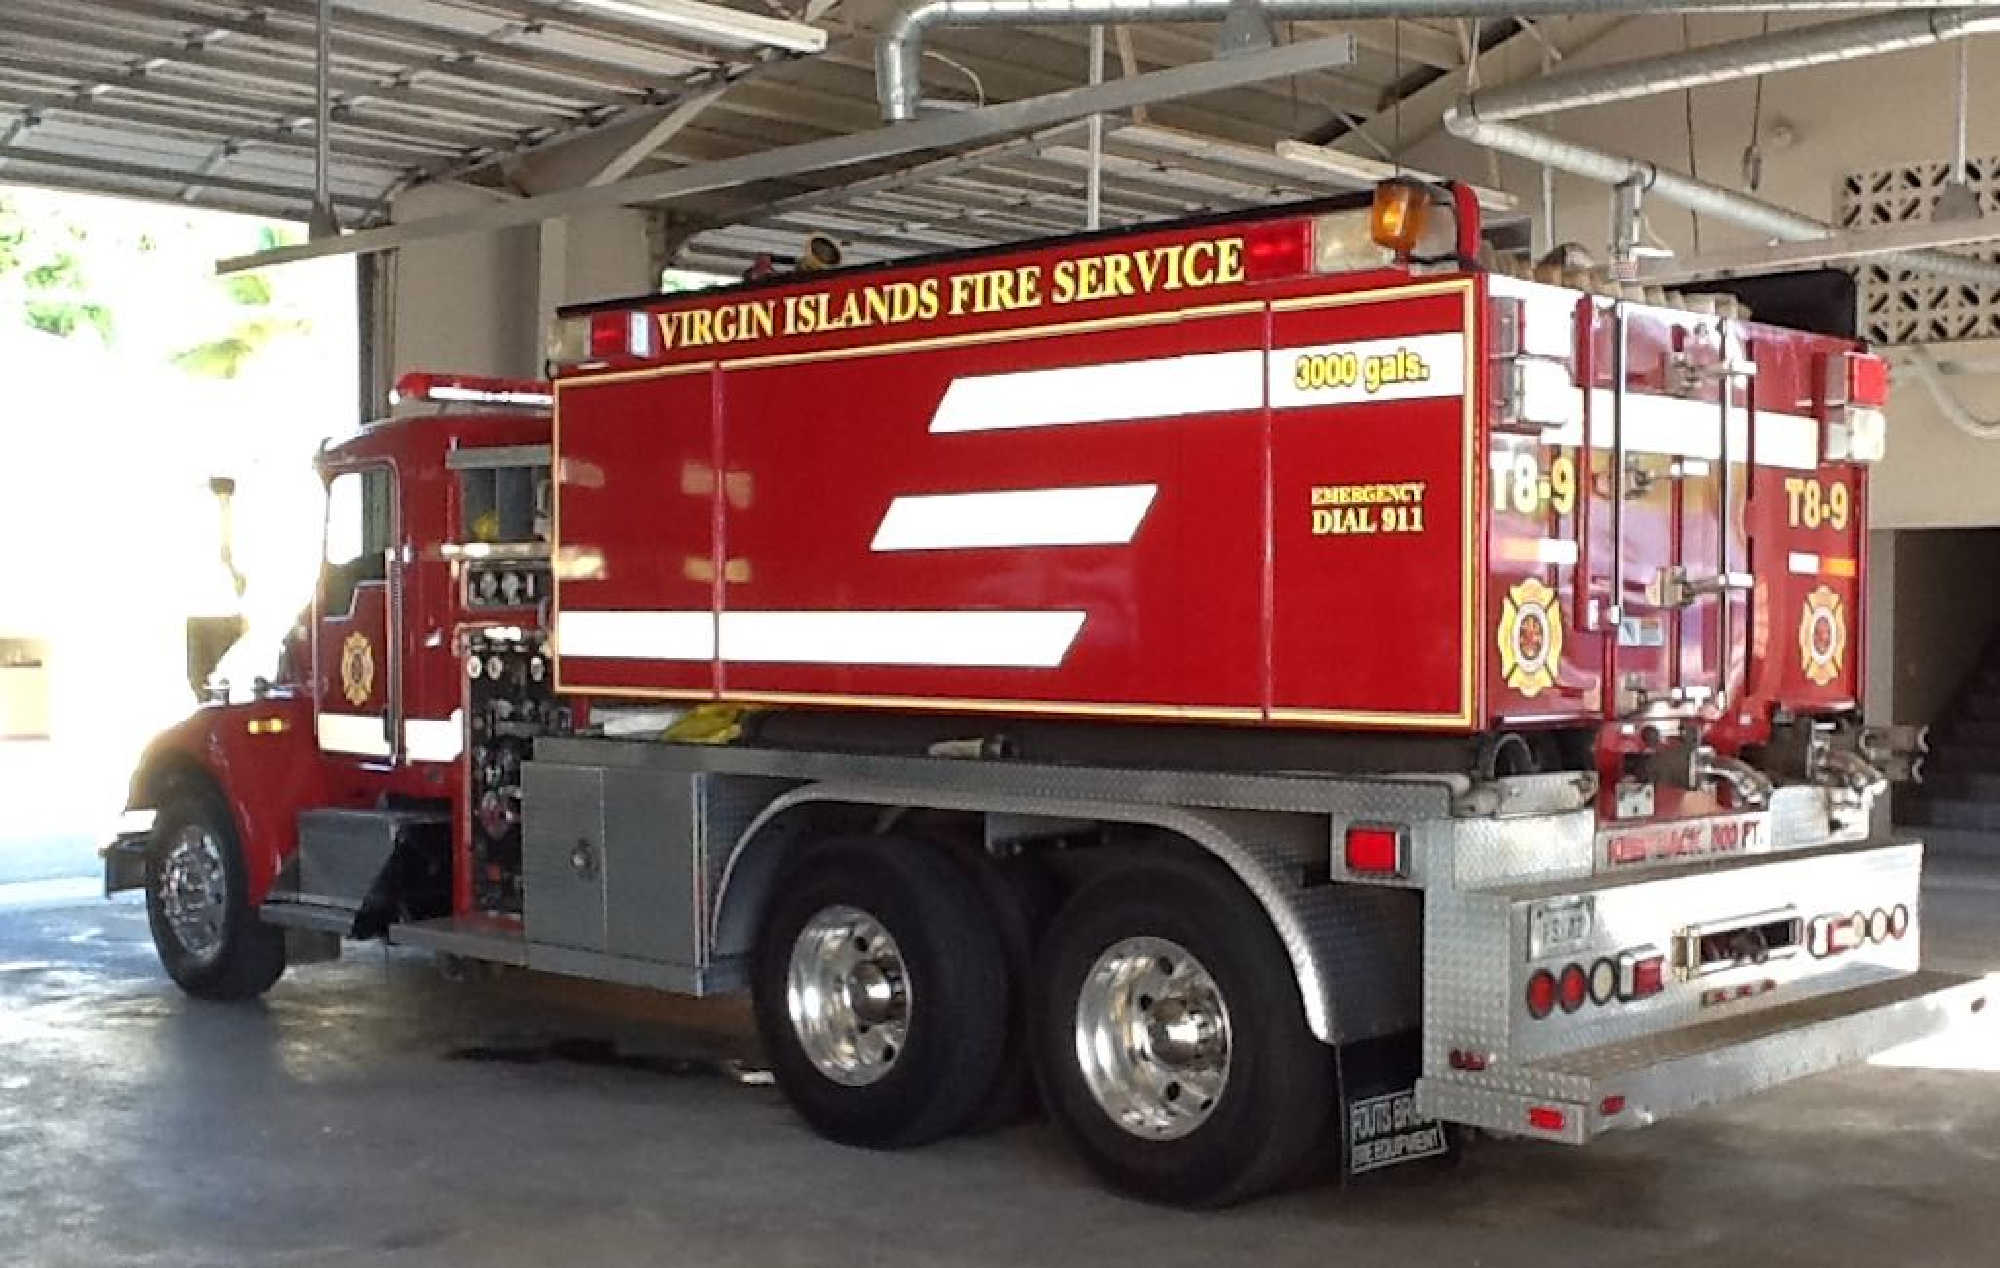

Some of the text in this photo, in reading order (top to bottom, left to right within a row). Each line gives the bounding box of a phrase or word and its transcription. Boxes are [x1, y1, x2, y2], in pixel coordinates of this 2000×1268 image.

[657, 237, 1245, 349] VIRGIN ISLANDS FIRE SERVICE
[1295, 346, 1430, 393] 3000 gals.
[1311, 481, 1426, 505] EMERGENCY
[1490, 450, 1576, 514] T8-9
[1785, 478, 1849, 530] T8-9
[1311, 506, 1424, 534] DIAL 911
